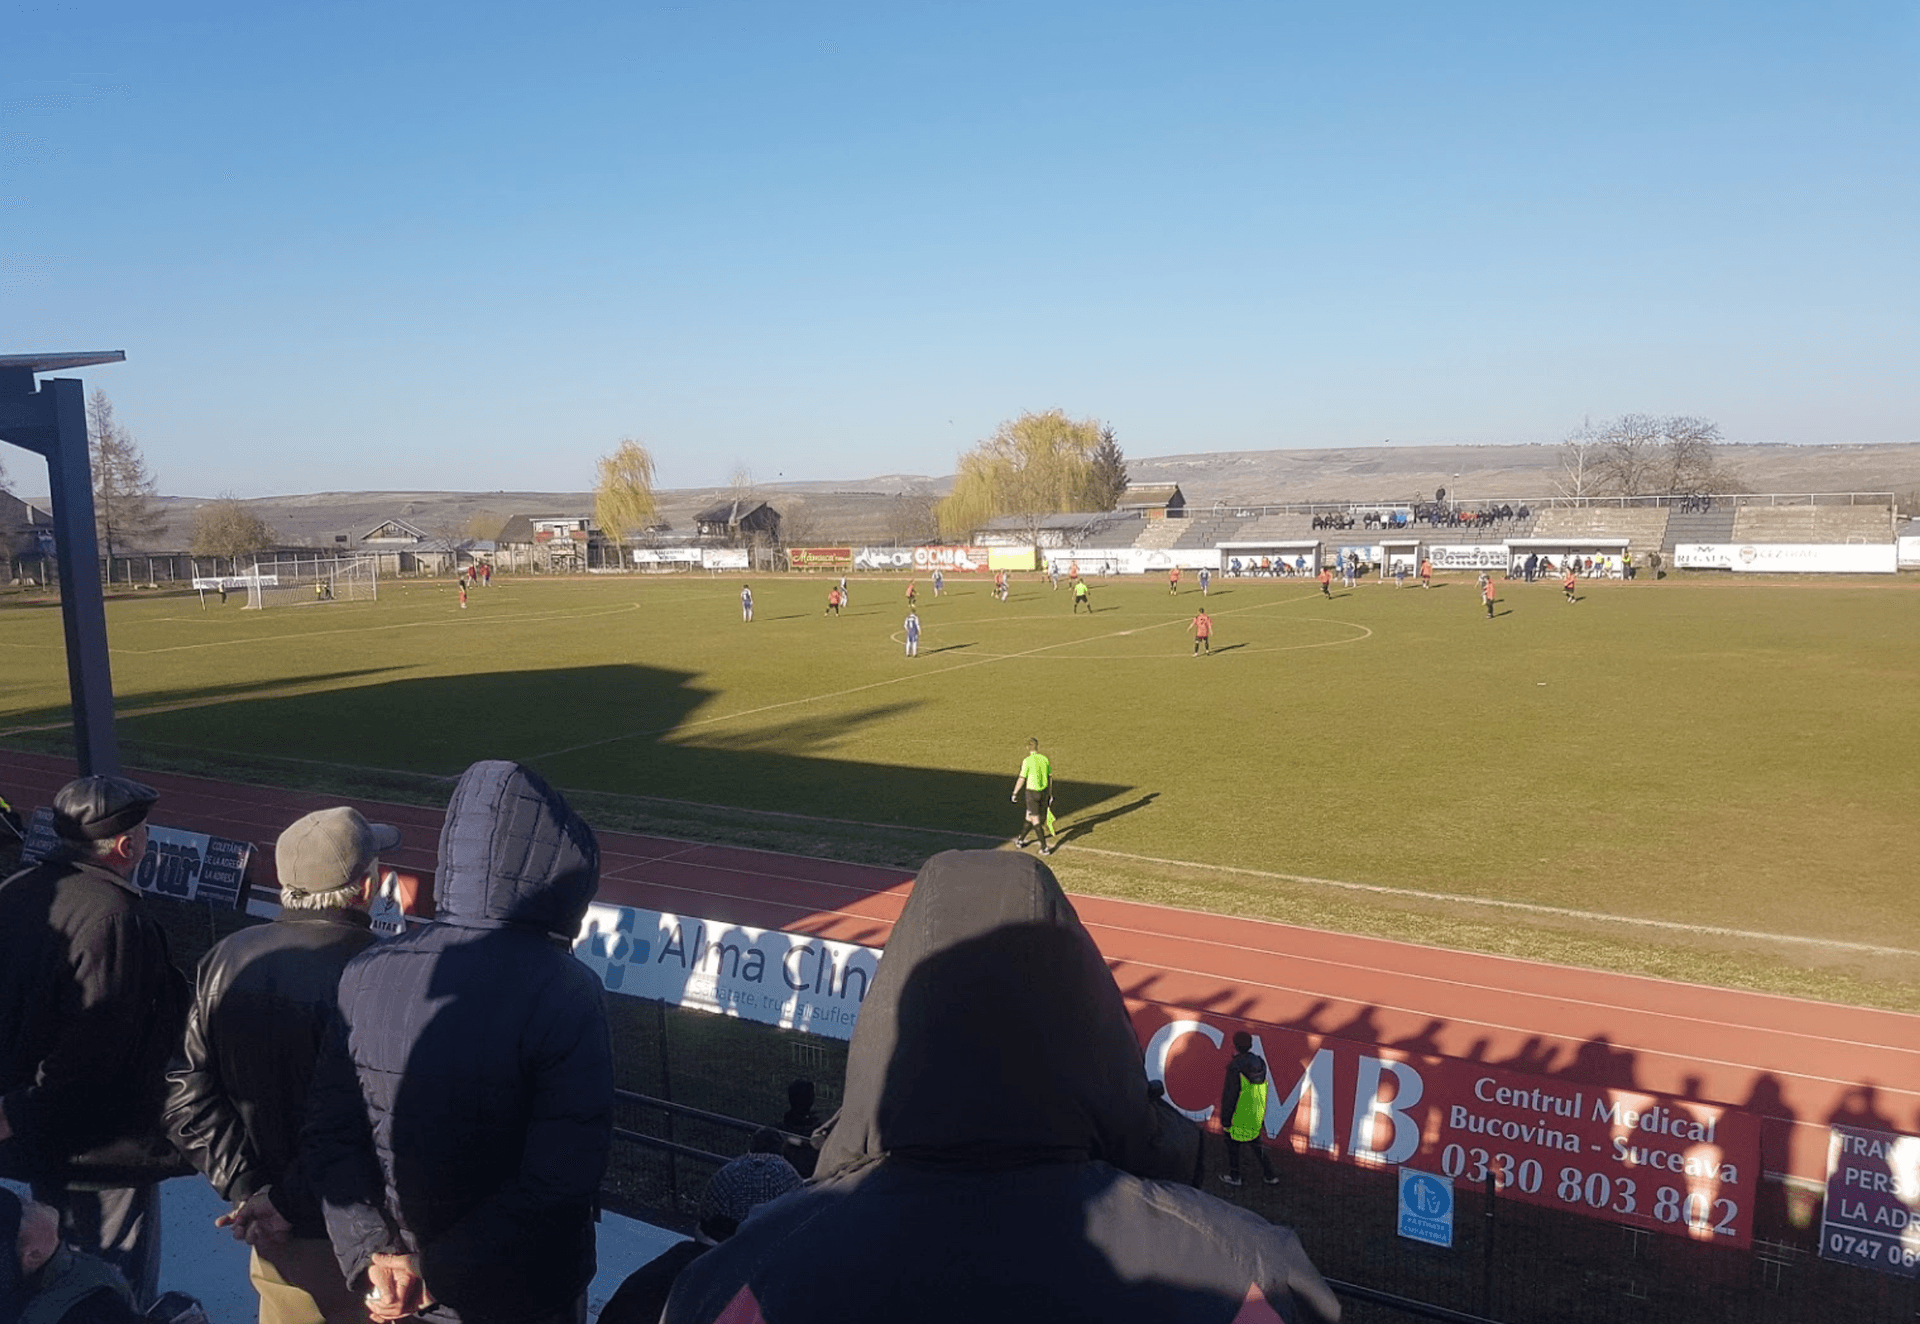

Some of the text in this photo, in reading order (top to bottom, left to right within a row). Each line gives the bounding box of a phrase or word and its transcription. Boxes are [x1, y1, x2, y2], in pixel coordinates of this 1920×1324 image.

[657, 923, 867, 1003] Alma Clin
[812, 1005, 857, 1026] suflet
[1144, 1020, 1424, 1165] CMB
[1474, 1077, 1716, 1143] Centrul Medical
[1449, 1104, 1580, 1153] Bucovina
[1612, 1135, 1738, 1185] Suceava
[1441, 1143, 1739, 1237] 0330 803 802
[1841, 1198, 1868, 1222] LA
[1830, 1233, 1920, 1268] 0747 06
